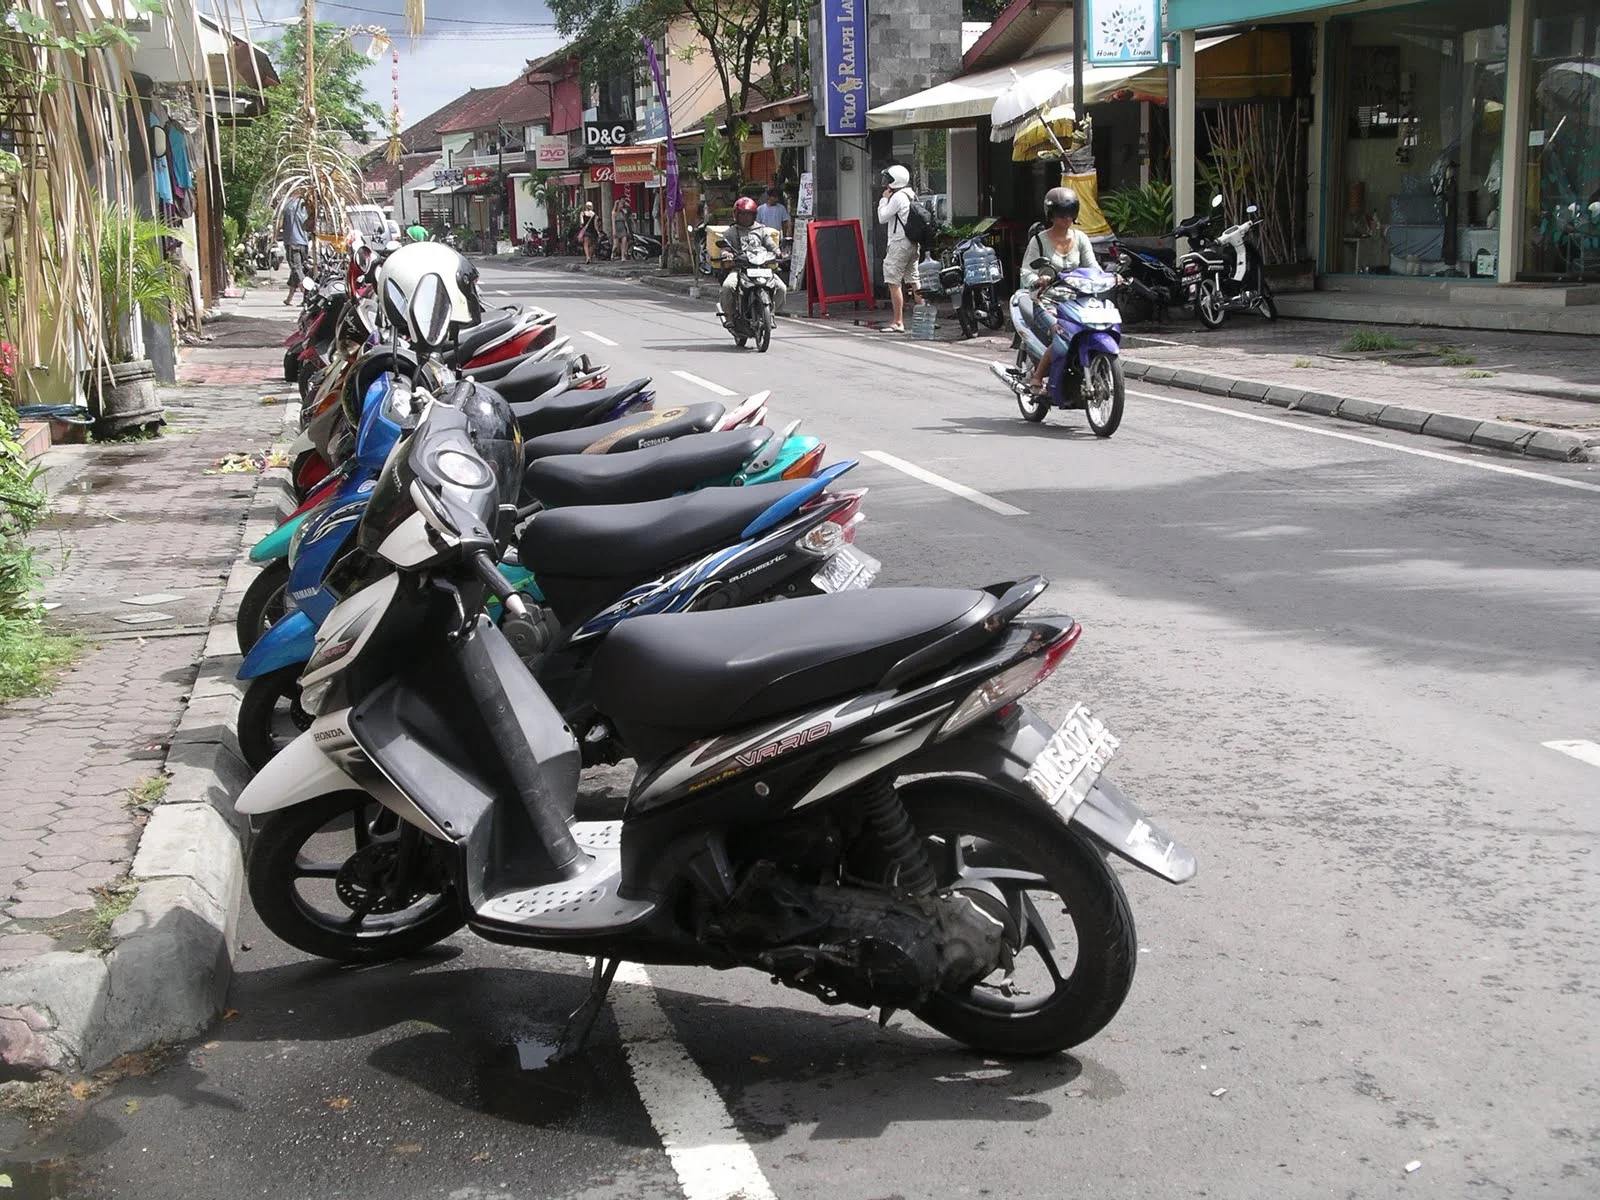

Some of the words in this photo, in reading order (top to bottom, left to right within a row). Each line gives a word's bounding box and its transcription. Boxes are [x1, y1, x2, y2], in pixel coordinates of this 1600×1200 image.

[837, 0, 854, 22] LA
[839, 26, 855, 75] RALPH
[587, 126, 626, 145] D&G
[540, 149, 566, 157] DVD
[292, 586, 318, 601] YAMAHA
[313, 727, 346, 742] HONDA
[735, 721, 832, 767] VARIO
